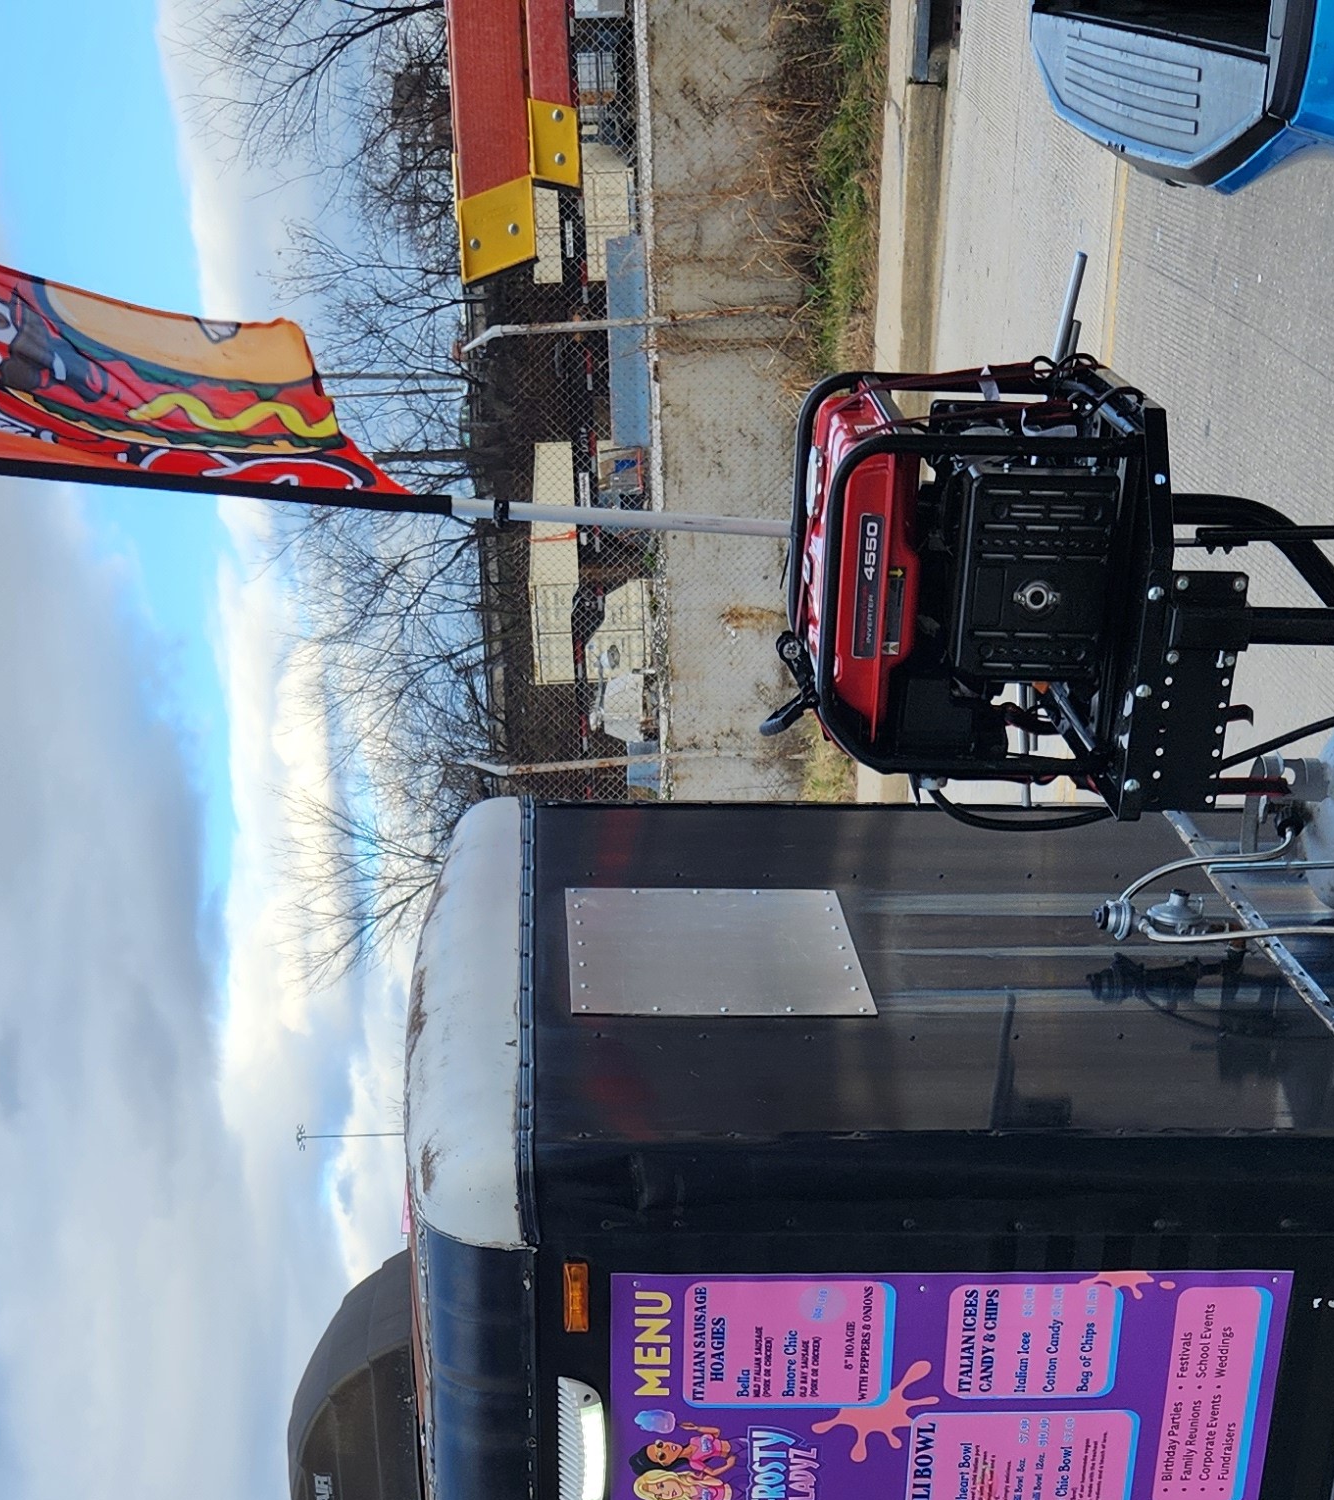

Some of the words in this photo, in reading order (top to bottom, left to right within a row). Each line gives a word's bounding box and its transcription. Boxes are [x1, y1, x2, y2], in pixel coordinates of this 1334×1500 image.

[864, 522, 878, 580] 4550
[866, 595, 874, 643] INVERTER
[694, 1287, 707, 1348] SAUSAGE
[862, 1286, 873, 1322] ONIONS
[963, 1290, 978, 1332] ICEES
[984, 1289, 999, 1330] CHIPS
[983, 1333, 996, 1342] &
[1046, 1319, 1063, 1354] Candy
[1080, 1323, 1096, 1353] Chips
[1201, 1304, 1215, 1339] Events
[633, 1291, 672, 1396] MENU
[710, 1317, 725, 1382] HOAGIES
[755, 1327, 763, 1355] SAUSAGE
[784, 1330, 798, 1355] Chic
[801, 1340, 809, 1369] SAUSAGE
[845, 1322, 855, 1357] HOAGIE
[860, 1332, 870, 1374] PEPPERS
[1017, 1332, 1031, 1354] Icee
[1177, 1332, 1192, 1378] Festivals
[1214, 1327, 1234, 1378] Weddings
[693, 1351, 705, 1401] ITALIAN
[754, 1357, 762, 1382] ITALIAN
[764, 1369, 771, 1377] OR
[958, 1335, 975, 1392] ITALIAN
[979, 1345, 994, 1392] CANDY
[1014, 1358, 1028, 1392] Italian
[1042, 1358, 1057, 1392] Cotton
[1079, 1355, 1091, 1367] of
[1196, 1342, 1210, 1378] School
[737, 1369, 750, 1397] Bella
[762, 1379, 772, 1397] (PORK
[782, 1359, 796, 1396] Bmore
[809, 1379, 819, 1397] (PORK
[858, 1376, 868, 1401] WITH
[1076, 1371, 1092, 1392] Bag
[1168, 1402, 1183, 1436] Parties
[1185, 1400, 1202, 1445] Reunions
[1207, 1394, 1221, 1428] Events
[913, 1423, 936, 1479] BOWL
[958, 1443, 972, 1468] Bowl
[1036, 1453, 1045, 1470] 12oz.
[1058, 1446, 1072, 1472] Bowl
[1162, 1439, 1180, 1481] Birthday
[1180, 1449, 1197, 1480] Family
[1199, 1431, 1216, 1481] Corporate
[1218, 1423, 1236, 1480] Fundraisers
[1014, 1476, 1023, 1492] Bowl
[1034, 1474, 1042, 1490] Bowl
[1055, 1475, 1069, 1497] Chic
